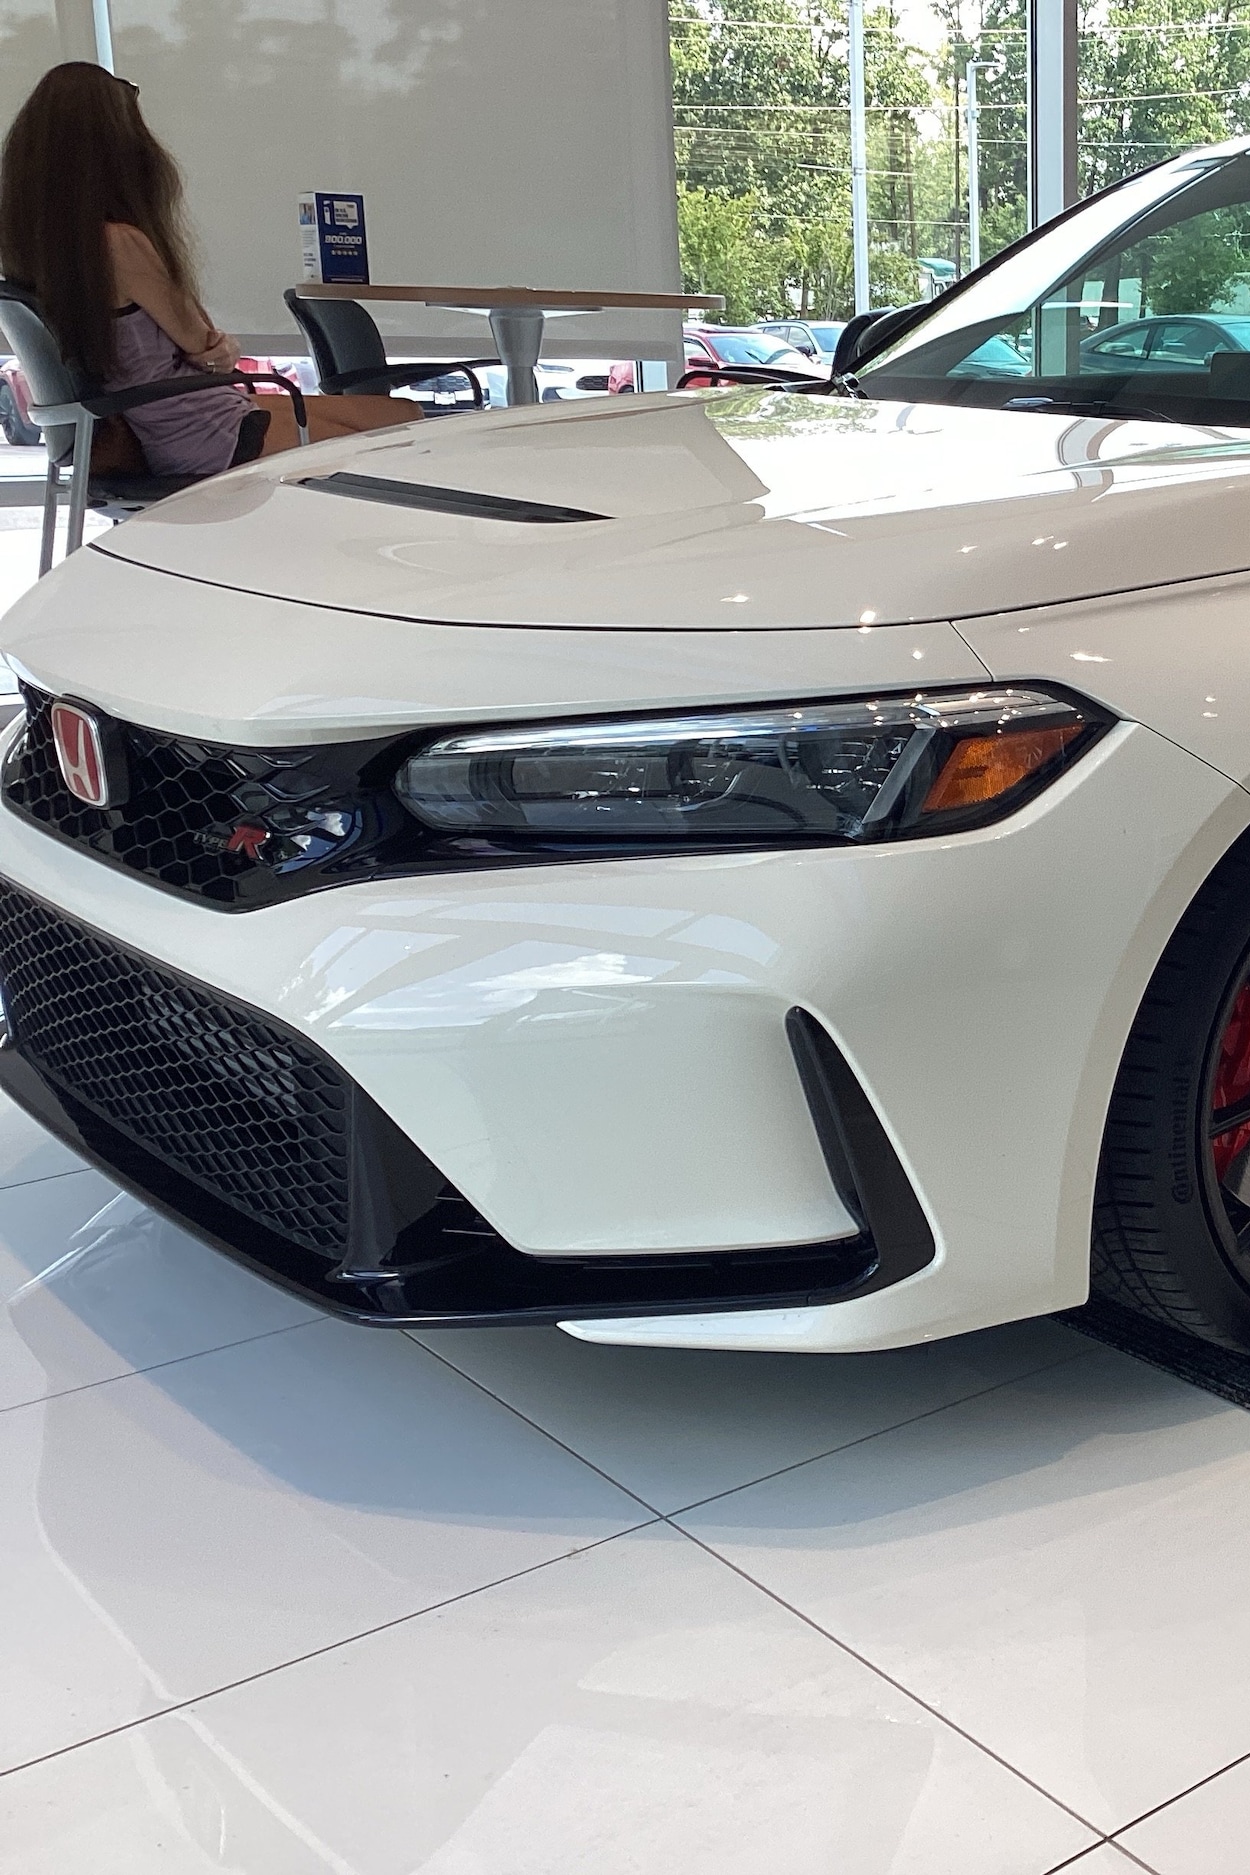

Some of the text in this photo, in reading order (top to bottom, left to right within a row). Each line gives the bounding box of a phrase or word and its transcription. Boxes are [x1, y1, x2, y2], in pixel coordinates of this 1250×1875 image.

[193, 824, 271, 861] TYPE R
[1168, 1077, 1193, 1204] Continental
